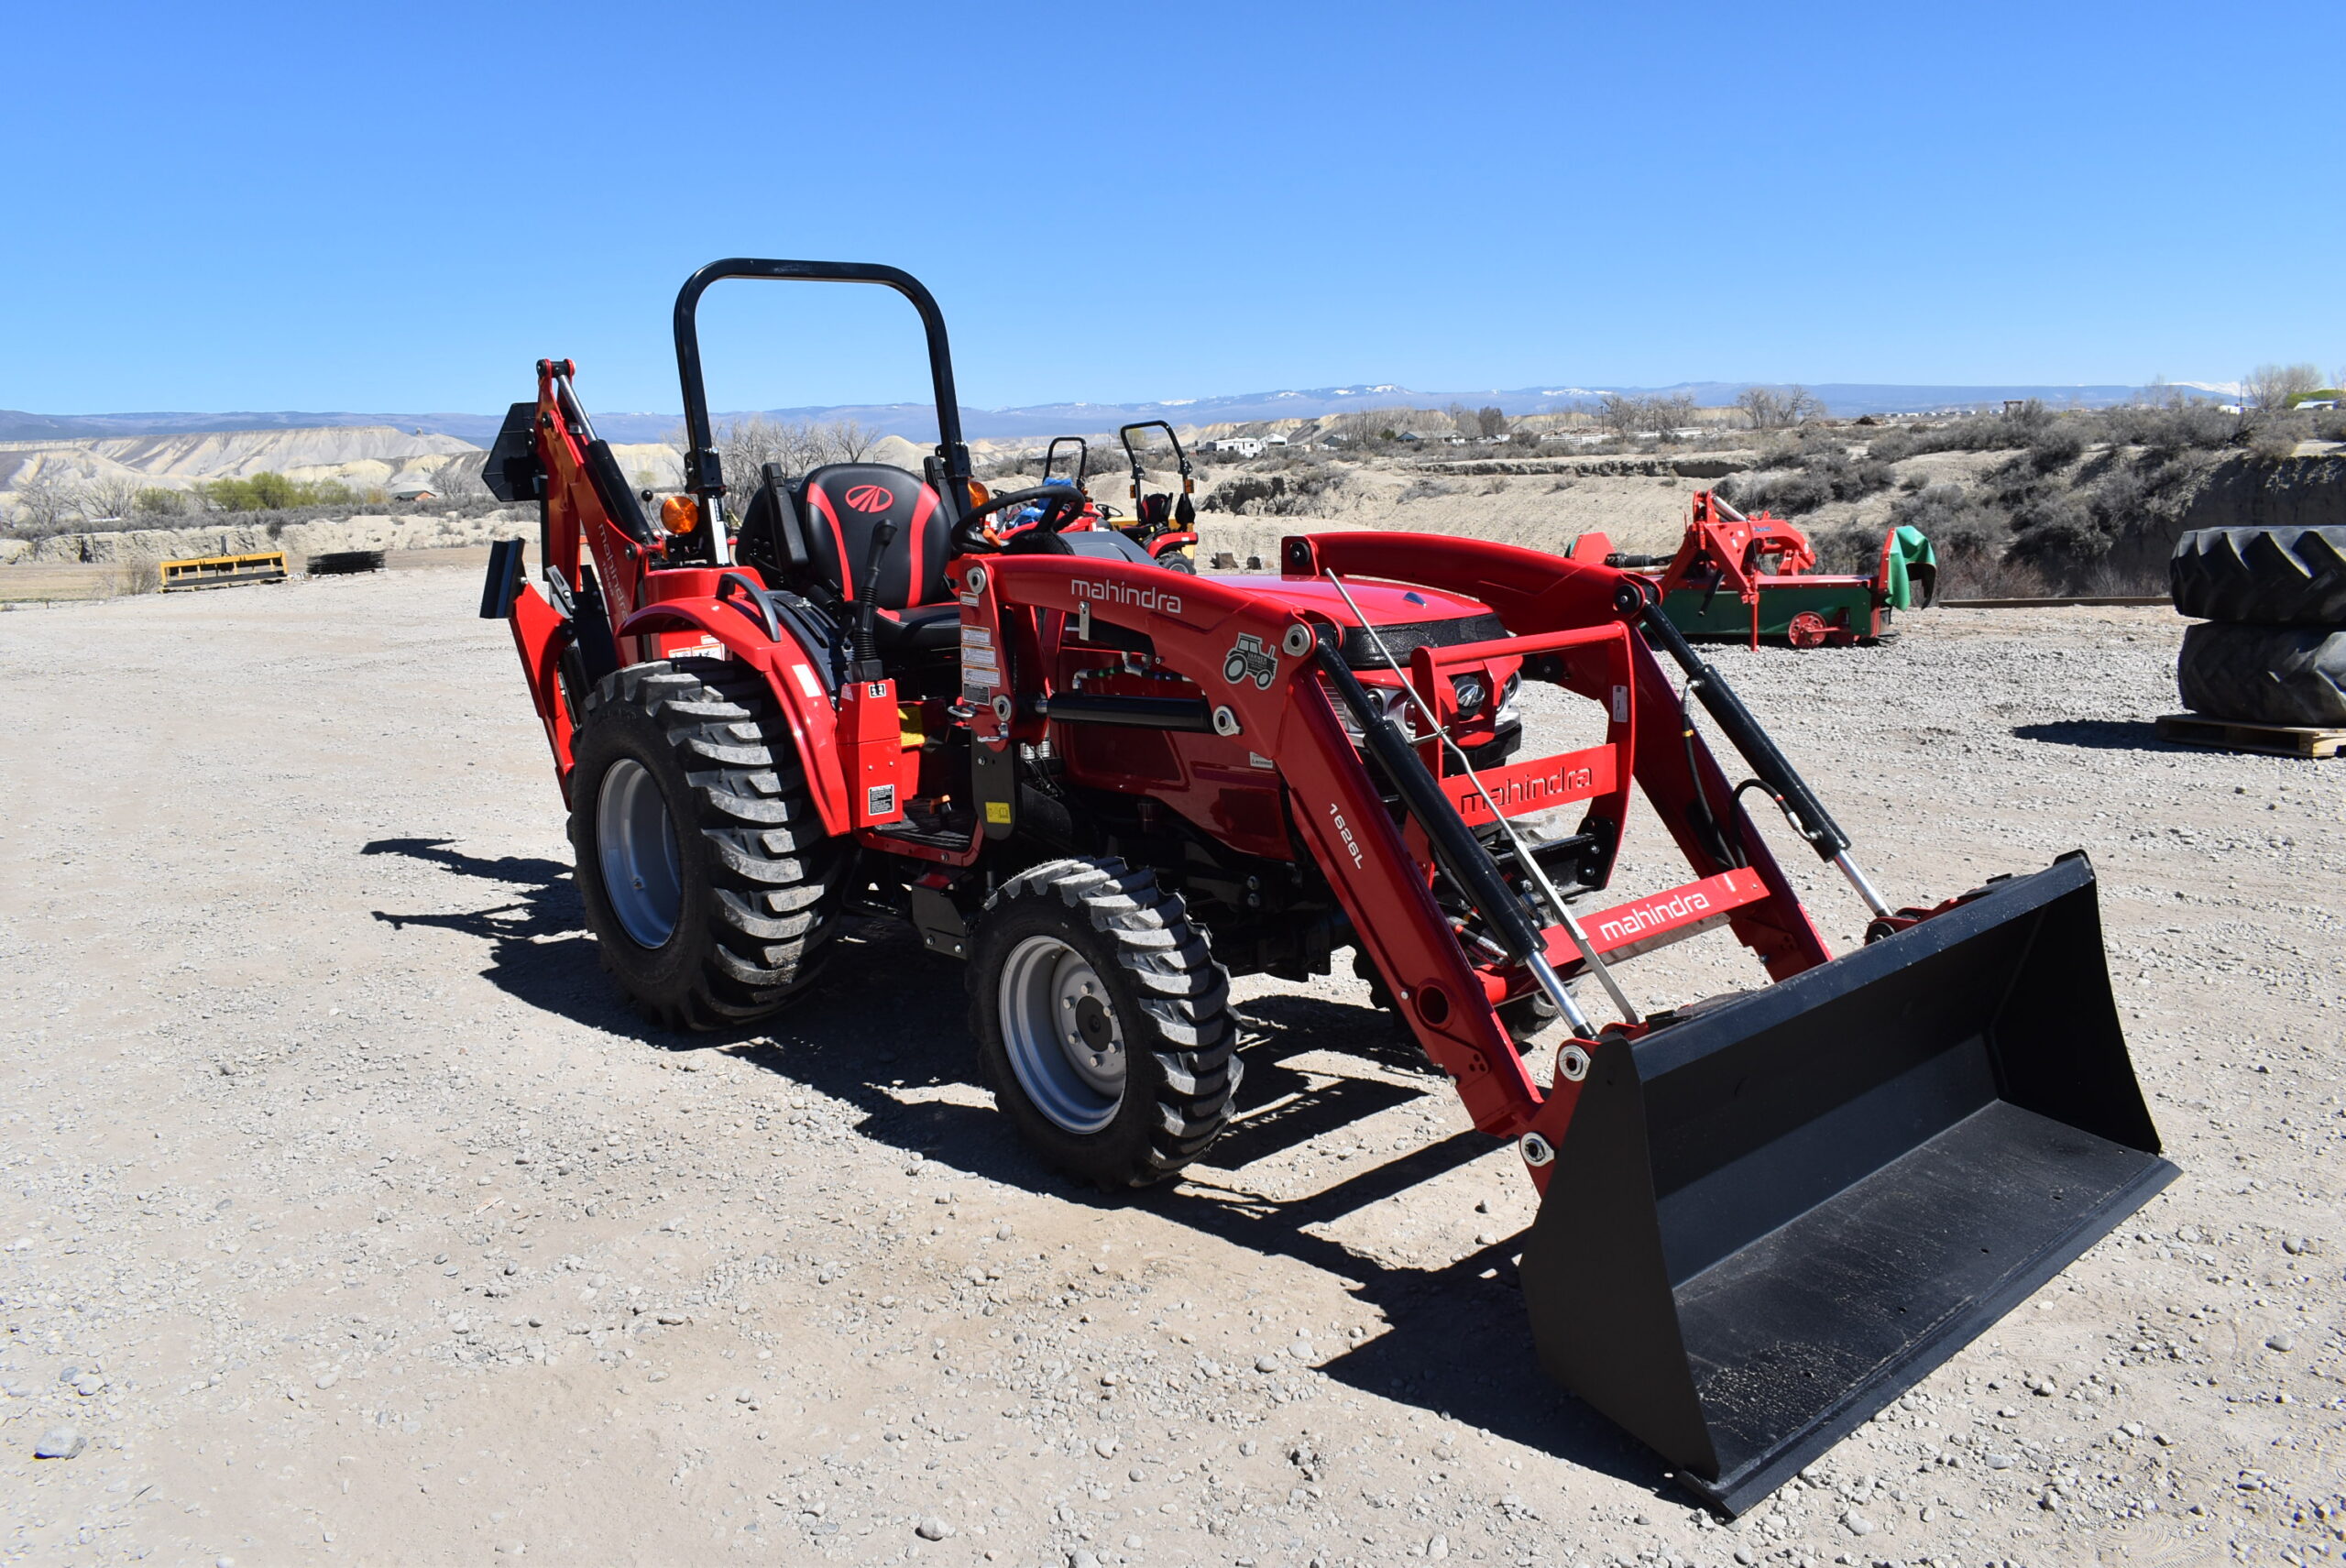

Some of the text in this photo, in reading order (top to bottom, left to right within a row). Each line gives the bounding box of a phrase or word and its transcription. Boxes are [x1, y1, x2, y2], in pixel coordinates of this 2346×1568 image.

[598, 523, 629, 620] mahindra
[1071, 579, 1181, 613] mahindra
[1461, 767, 1592, 815] mahindra
[1330, 803, 1363, 870] 1626L
[1599, 894, 1710, 941] mahindra
